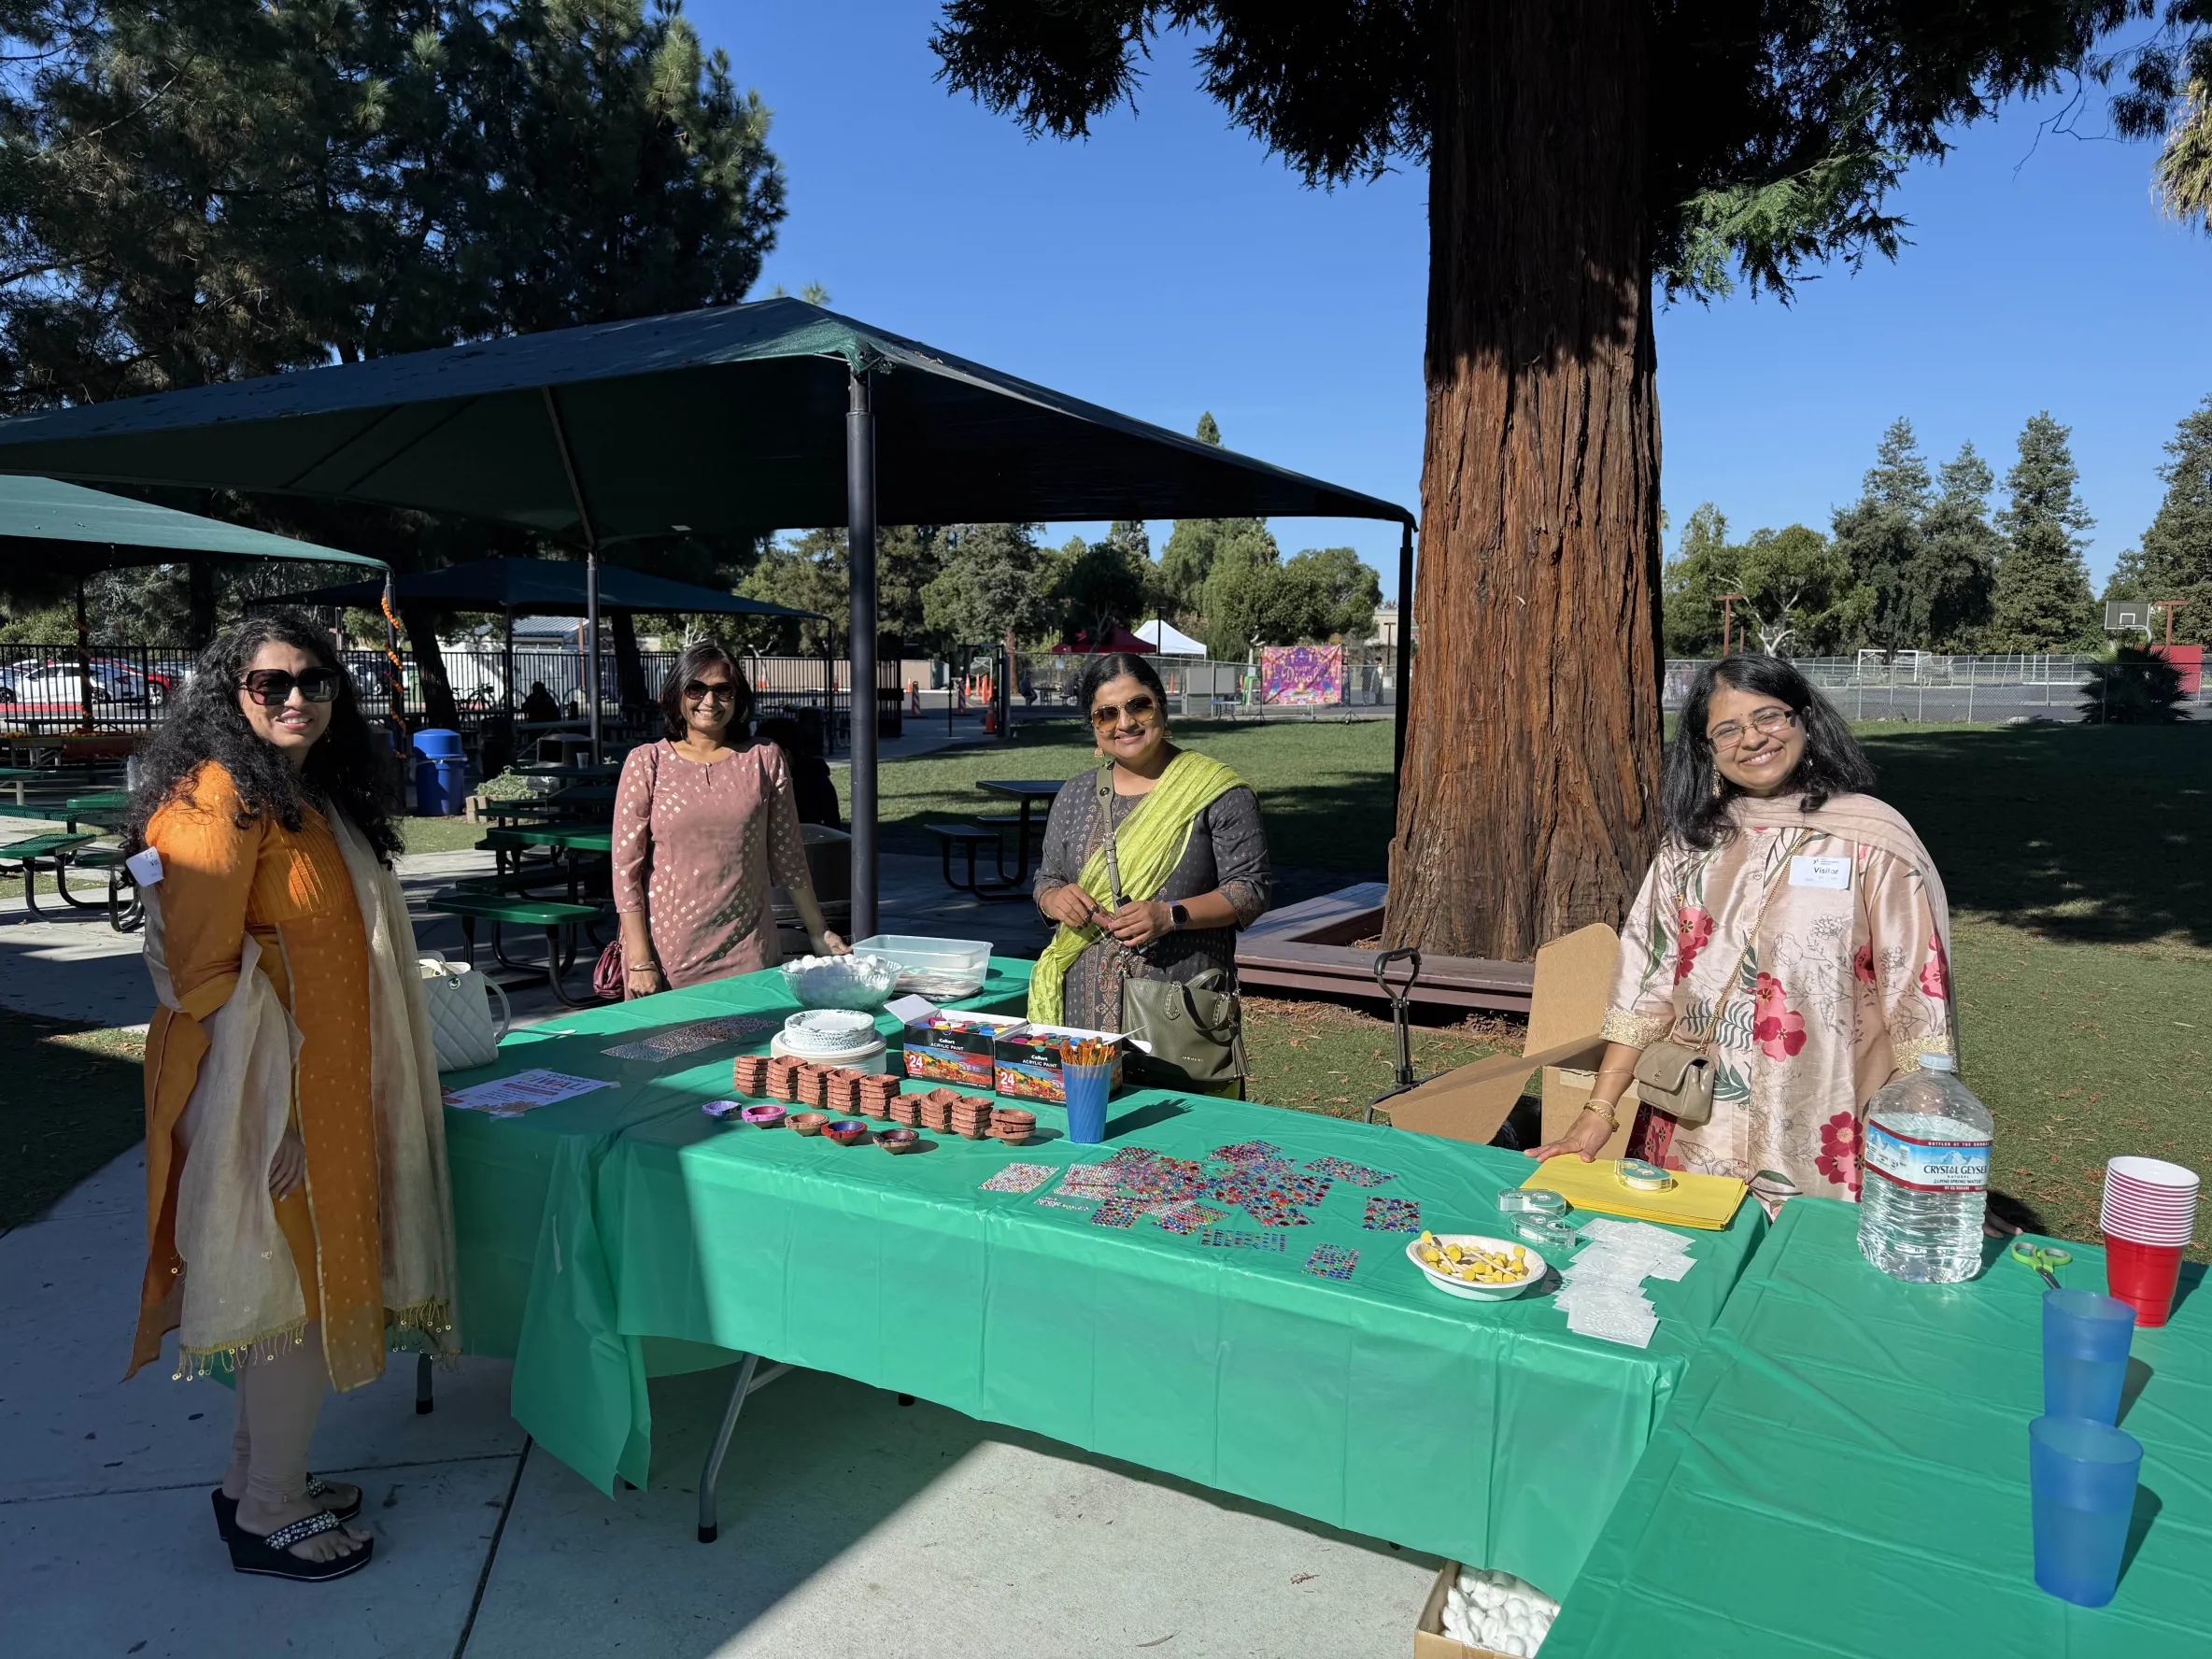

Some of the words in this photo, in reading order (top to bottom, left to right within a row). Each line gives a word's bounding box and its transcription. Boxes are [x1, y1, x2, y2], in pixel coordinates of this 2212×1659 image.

[1282, 666, 1321, 683] Diwali
[909, 1055, 923, 1068] 24
[1000, 1071, 1014, 1085] 24
[1923, 1165, 1959, 1174] CRYSTAL
